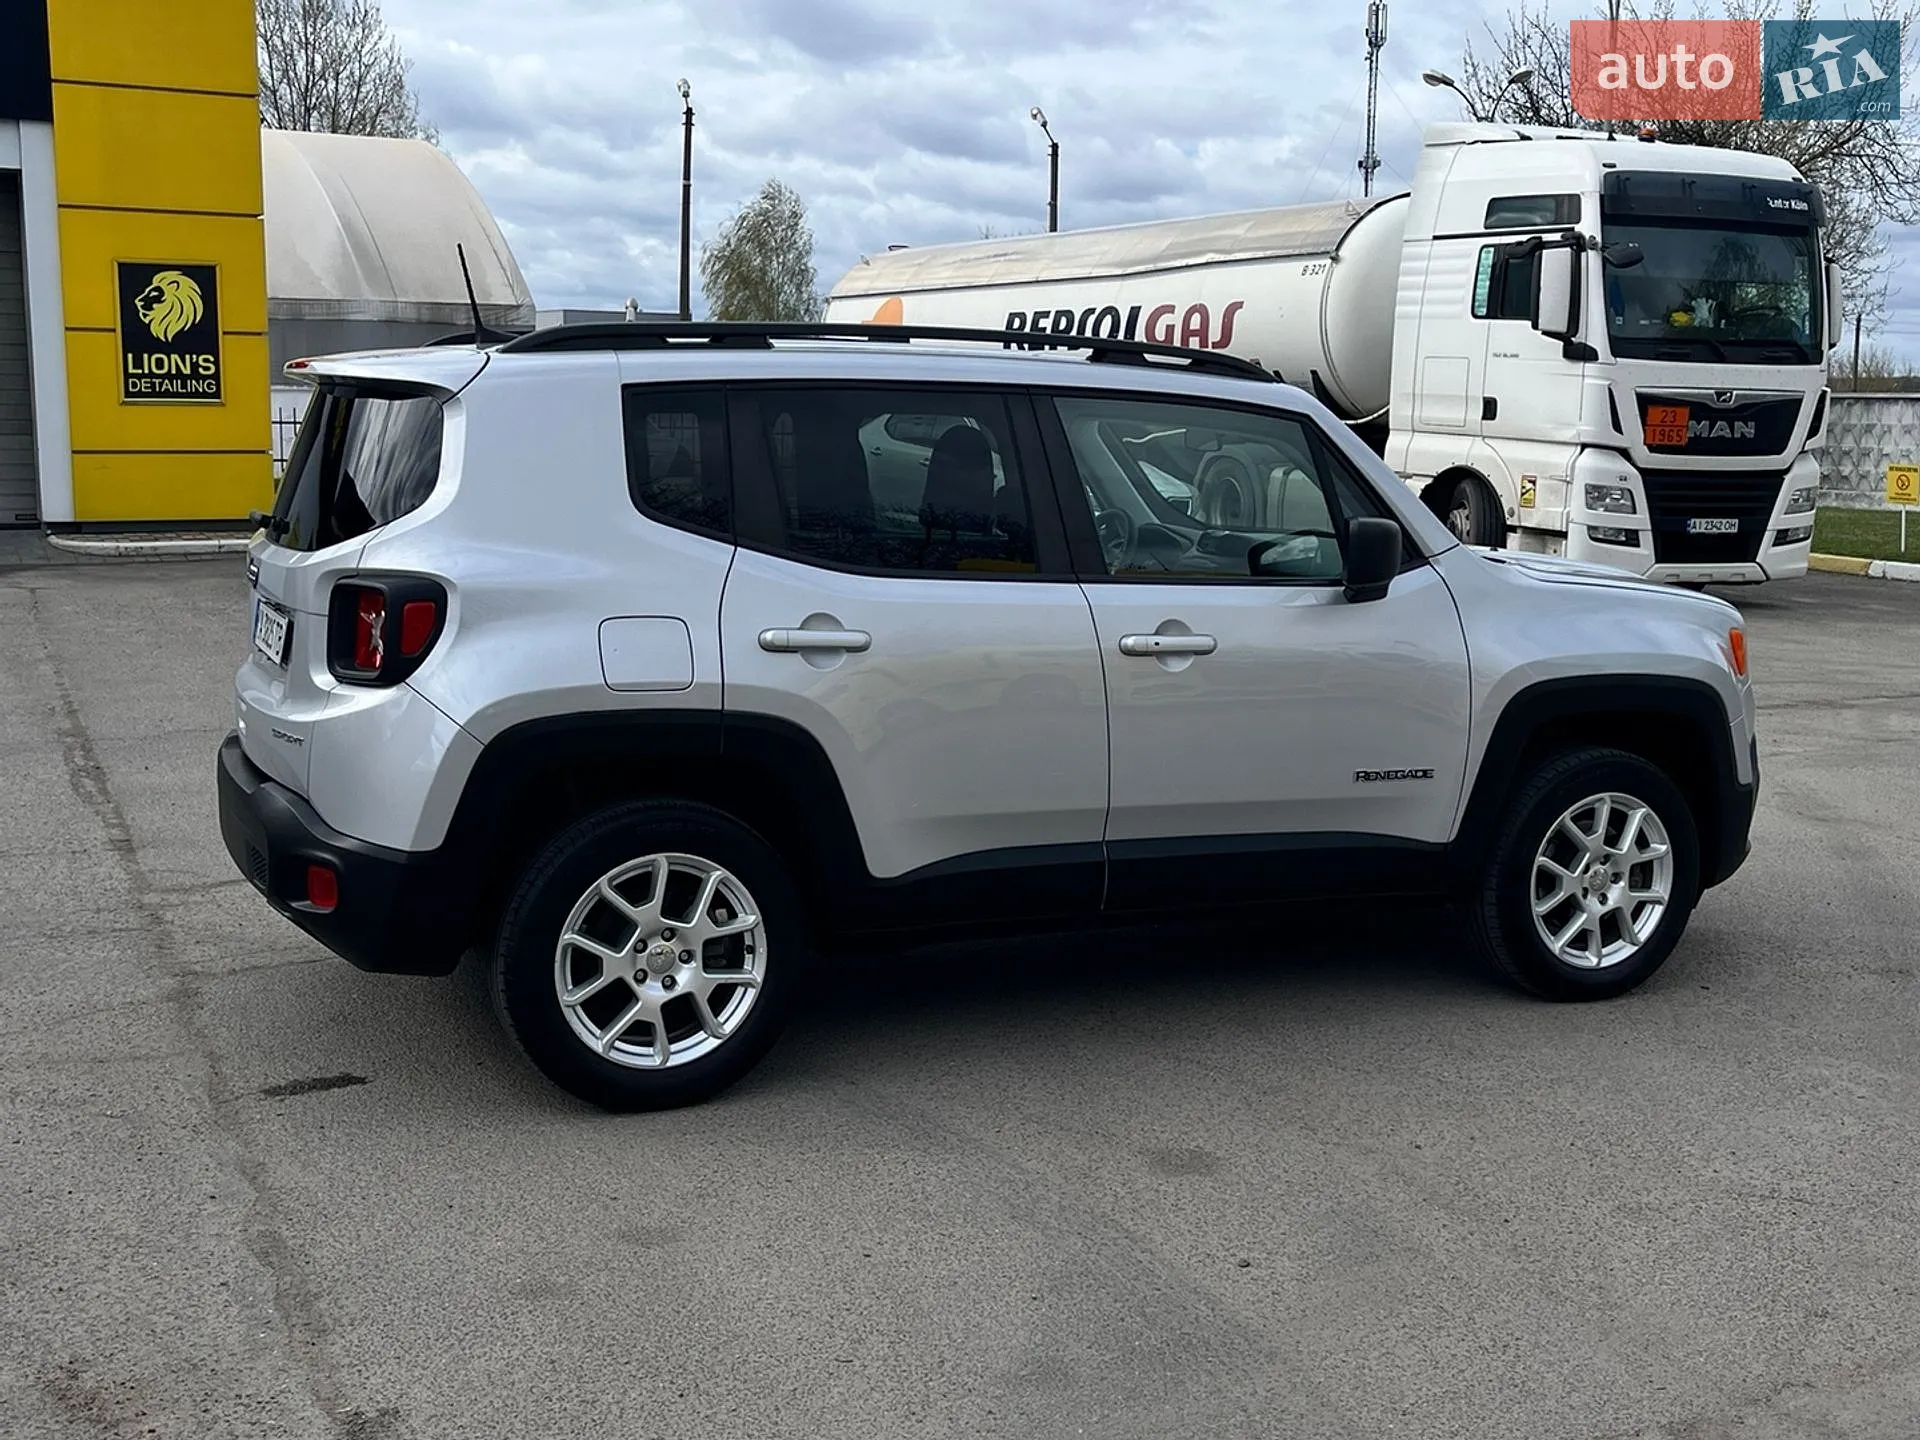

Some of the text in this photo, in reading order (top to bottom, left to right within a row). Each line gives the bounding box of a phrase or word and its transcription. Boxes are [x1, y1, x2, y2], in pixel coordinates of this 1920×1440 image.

[127, 353, 216, 375] LION'S
[128, 378, 217, 393] DETAILING
[1659, 409, 1677, 424] 23
[1651, 428, 1684, 443] 1965
[1687, 420, 1756, 438] MAN
[1354, 768, 1435, 783] RENEGADE
